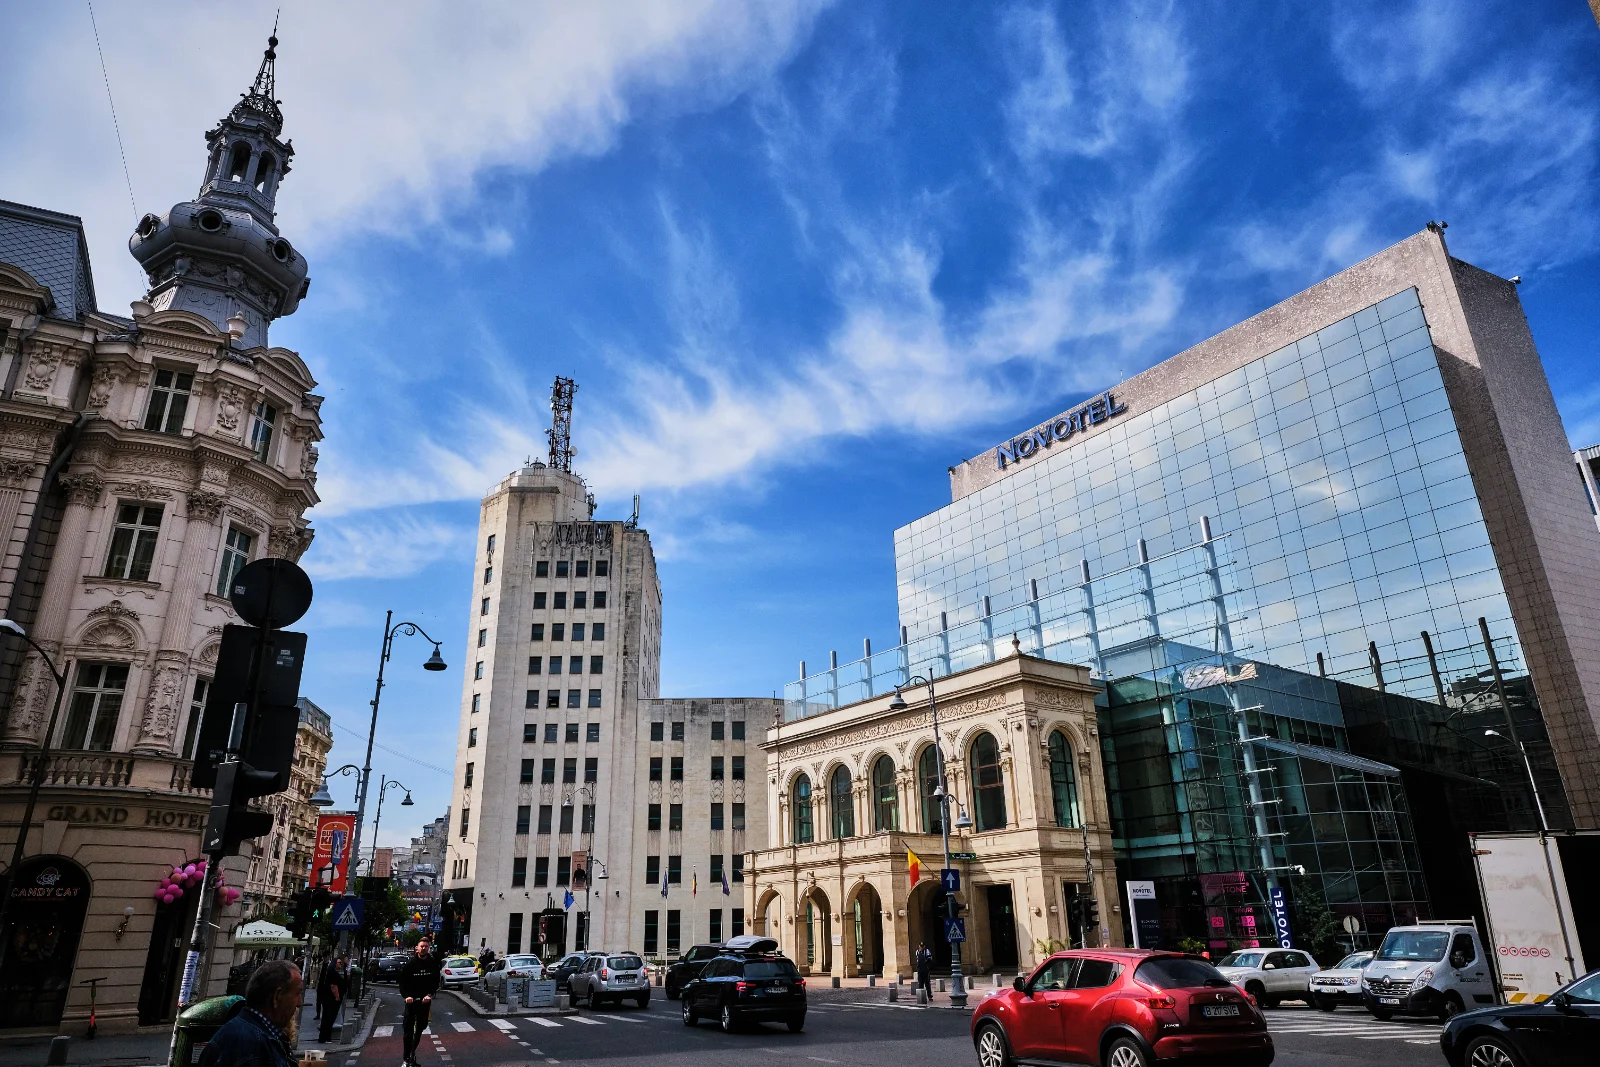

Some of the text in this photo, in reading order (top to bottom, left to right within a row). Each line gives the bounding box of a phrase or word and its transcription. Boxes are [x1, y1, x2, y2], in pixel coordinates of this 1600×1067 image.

[996, 391, 1126, 469] NOVOTEL
[48, 805, 209, 829] GRAND HOTEL
[10, 886, 80, 898] CANDY CAT
[1273, 890, 1291, 949] OVOTEL
[1205, 1006, 1211, 1015] B
[1224, 1005, 1238, 1015] SVE
